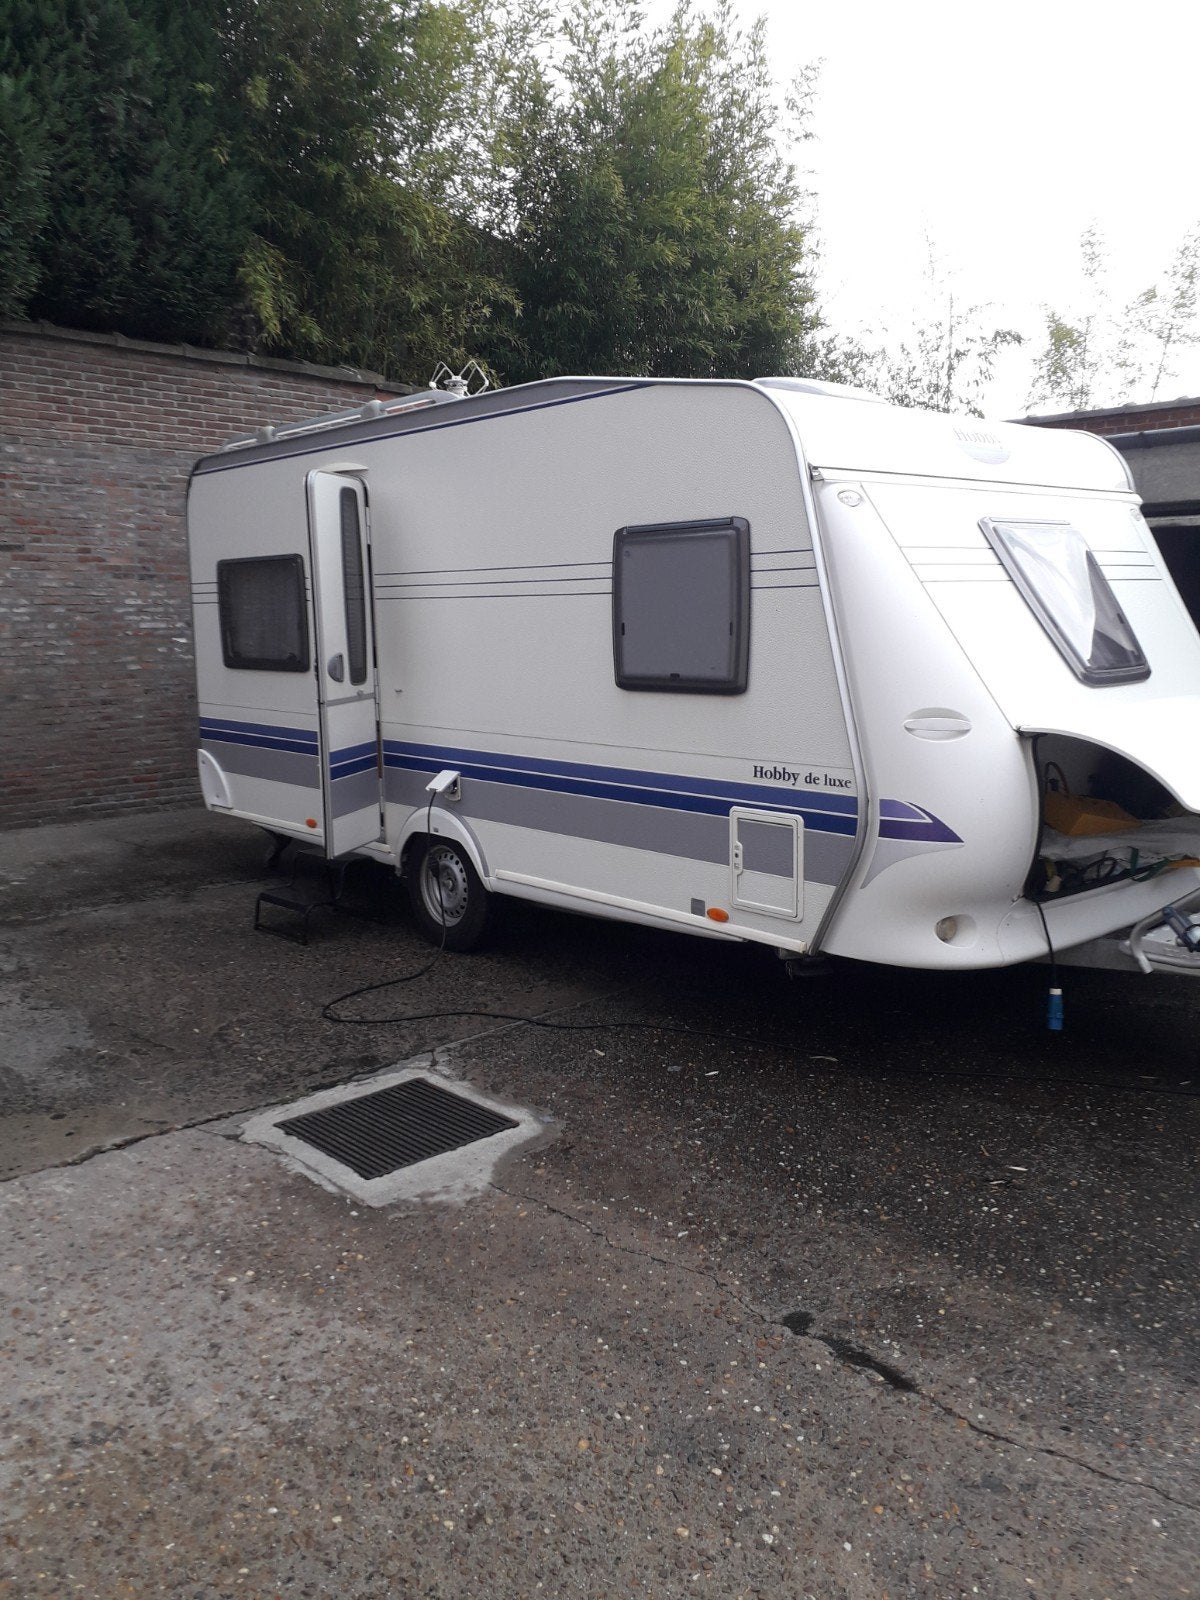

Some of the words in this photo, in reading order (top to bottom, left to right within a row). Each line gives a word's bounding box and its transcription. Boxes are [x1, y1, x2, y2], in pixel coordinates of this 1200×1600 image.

[753, 765, 800, 785] Hobby
[804, 772, 820, 785] de
[824, 774, 852, 788] luxe
